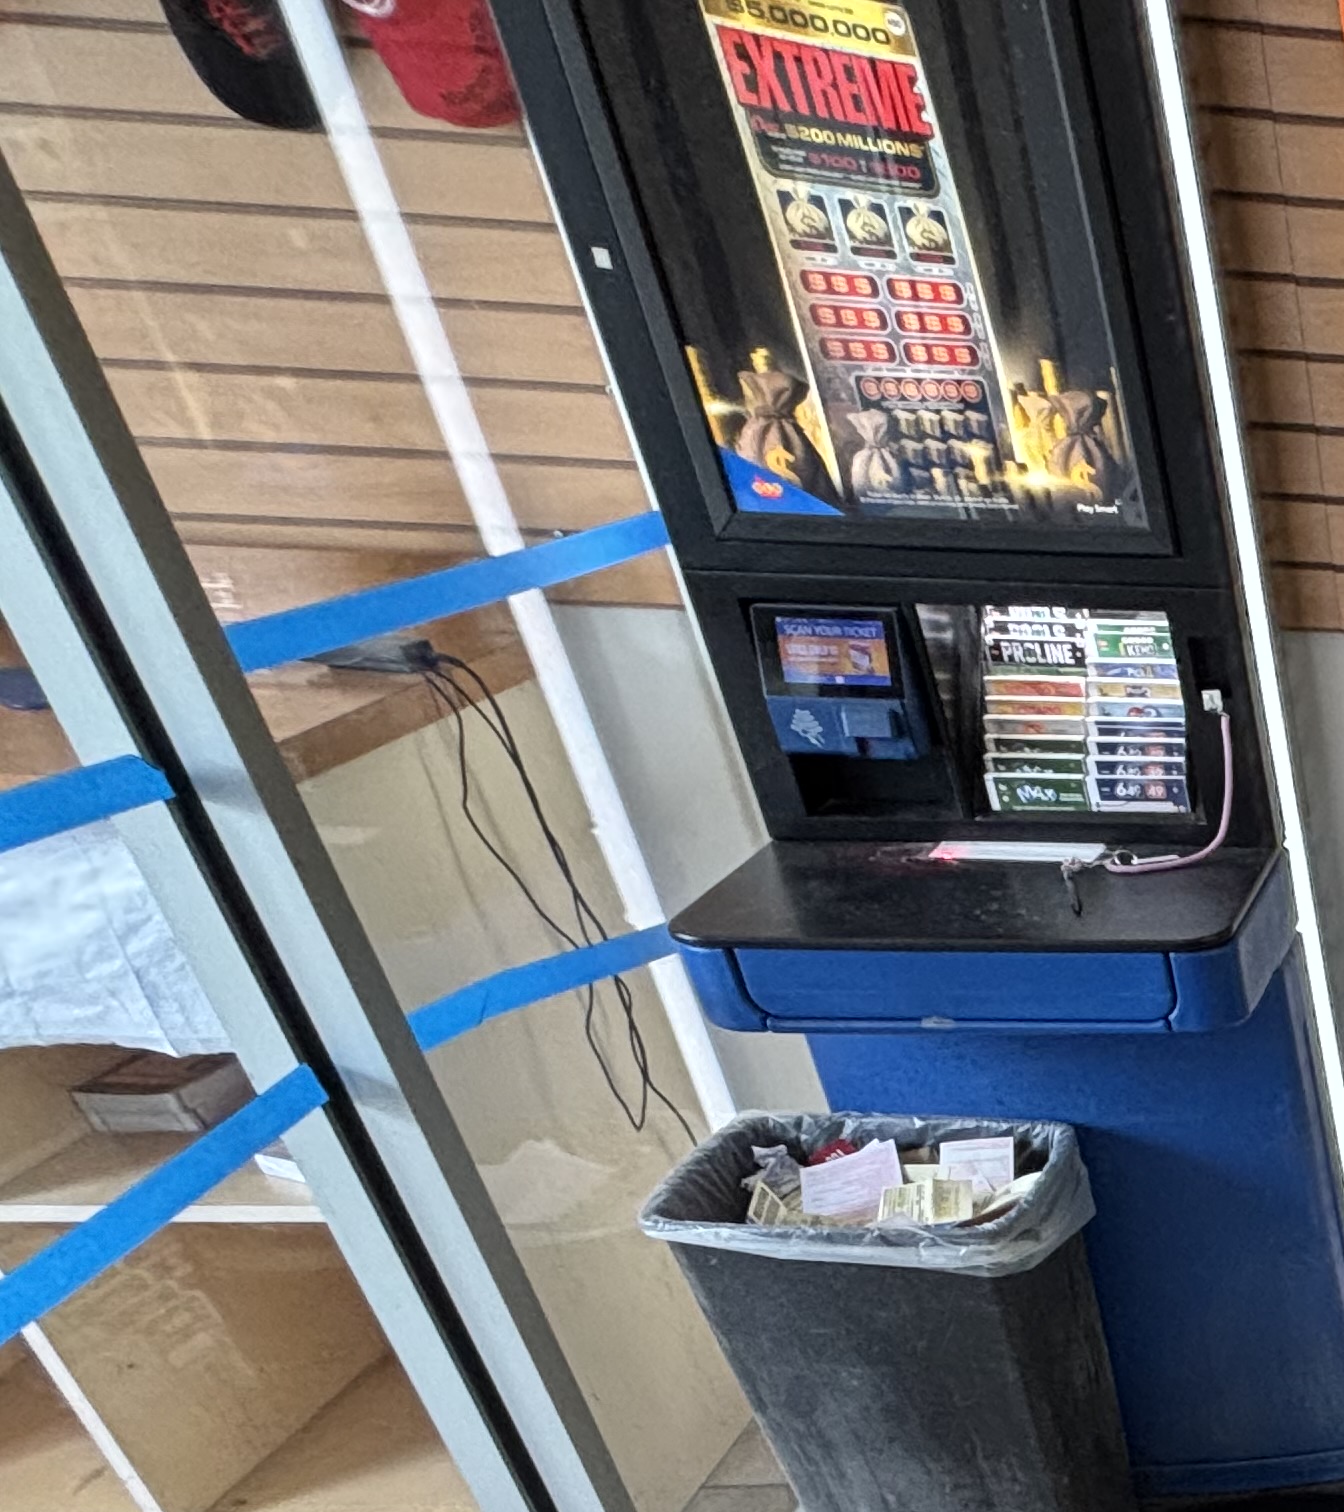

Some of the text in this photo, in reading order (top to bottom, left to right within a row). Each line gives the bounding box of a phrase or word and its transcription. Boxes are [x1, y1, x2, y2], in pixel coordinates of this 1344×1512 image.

[715, 24, 934, 138] EXTREME
[837, 134, 924, 158] MILLIONS
[783, 625, 877, 637] SCAN YOUR TICKET
